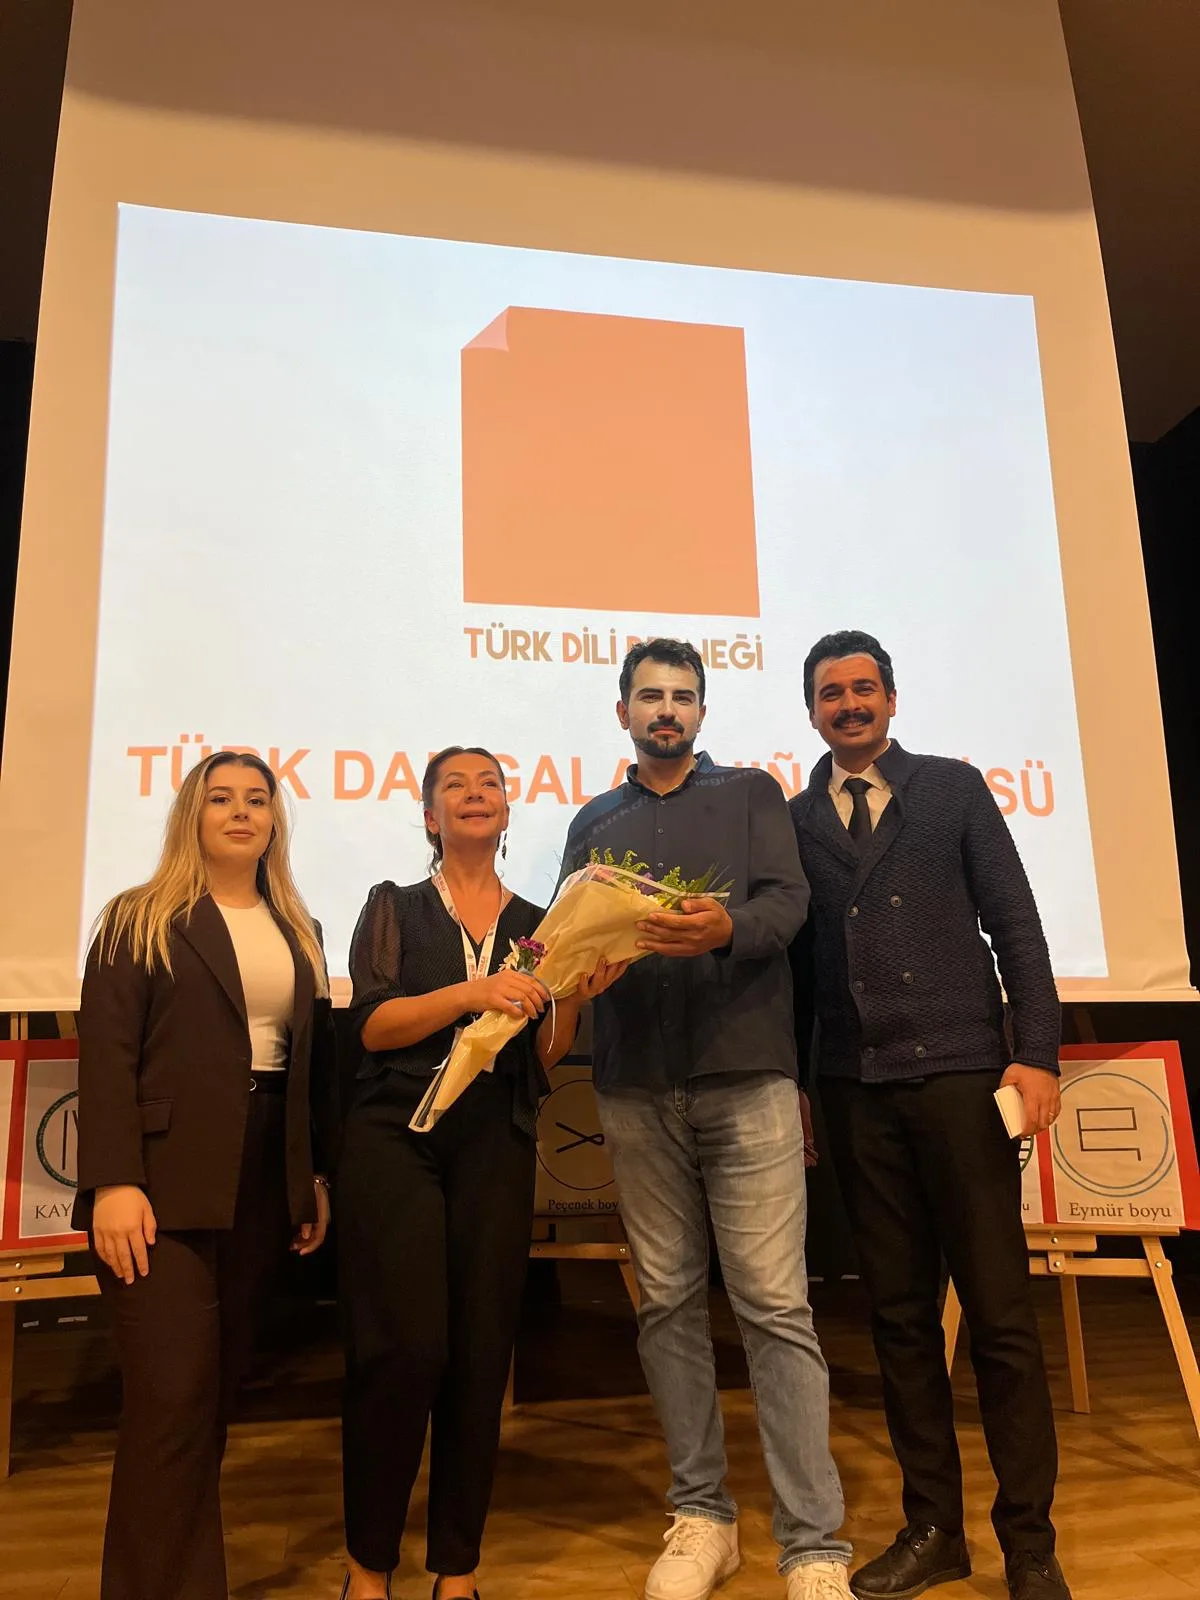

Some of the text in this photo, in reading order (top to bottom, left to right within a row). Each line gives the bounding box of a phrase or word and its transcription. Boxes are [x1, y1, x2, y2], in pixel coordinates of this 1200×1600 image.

[464, 622, 553, 662] TÜRK
[562, 626, 617, 665] DİLİ
[127, 733, 312, 800] TÜK
[35, 1203, 72, 1219] KAY
[548, 1198, 619, 1213] Peçenek boy
[1069, 1201, 1172, 1222] Eymür boyu
